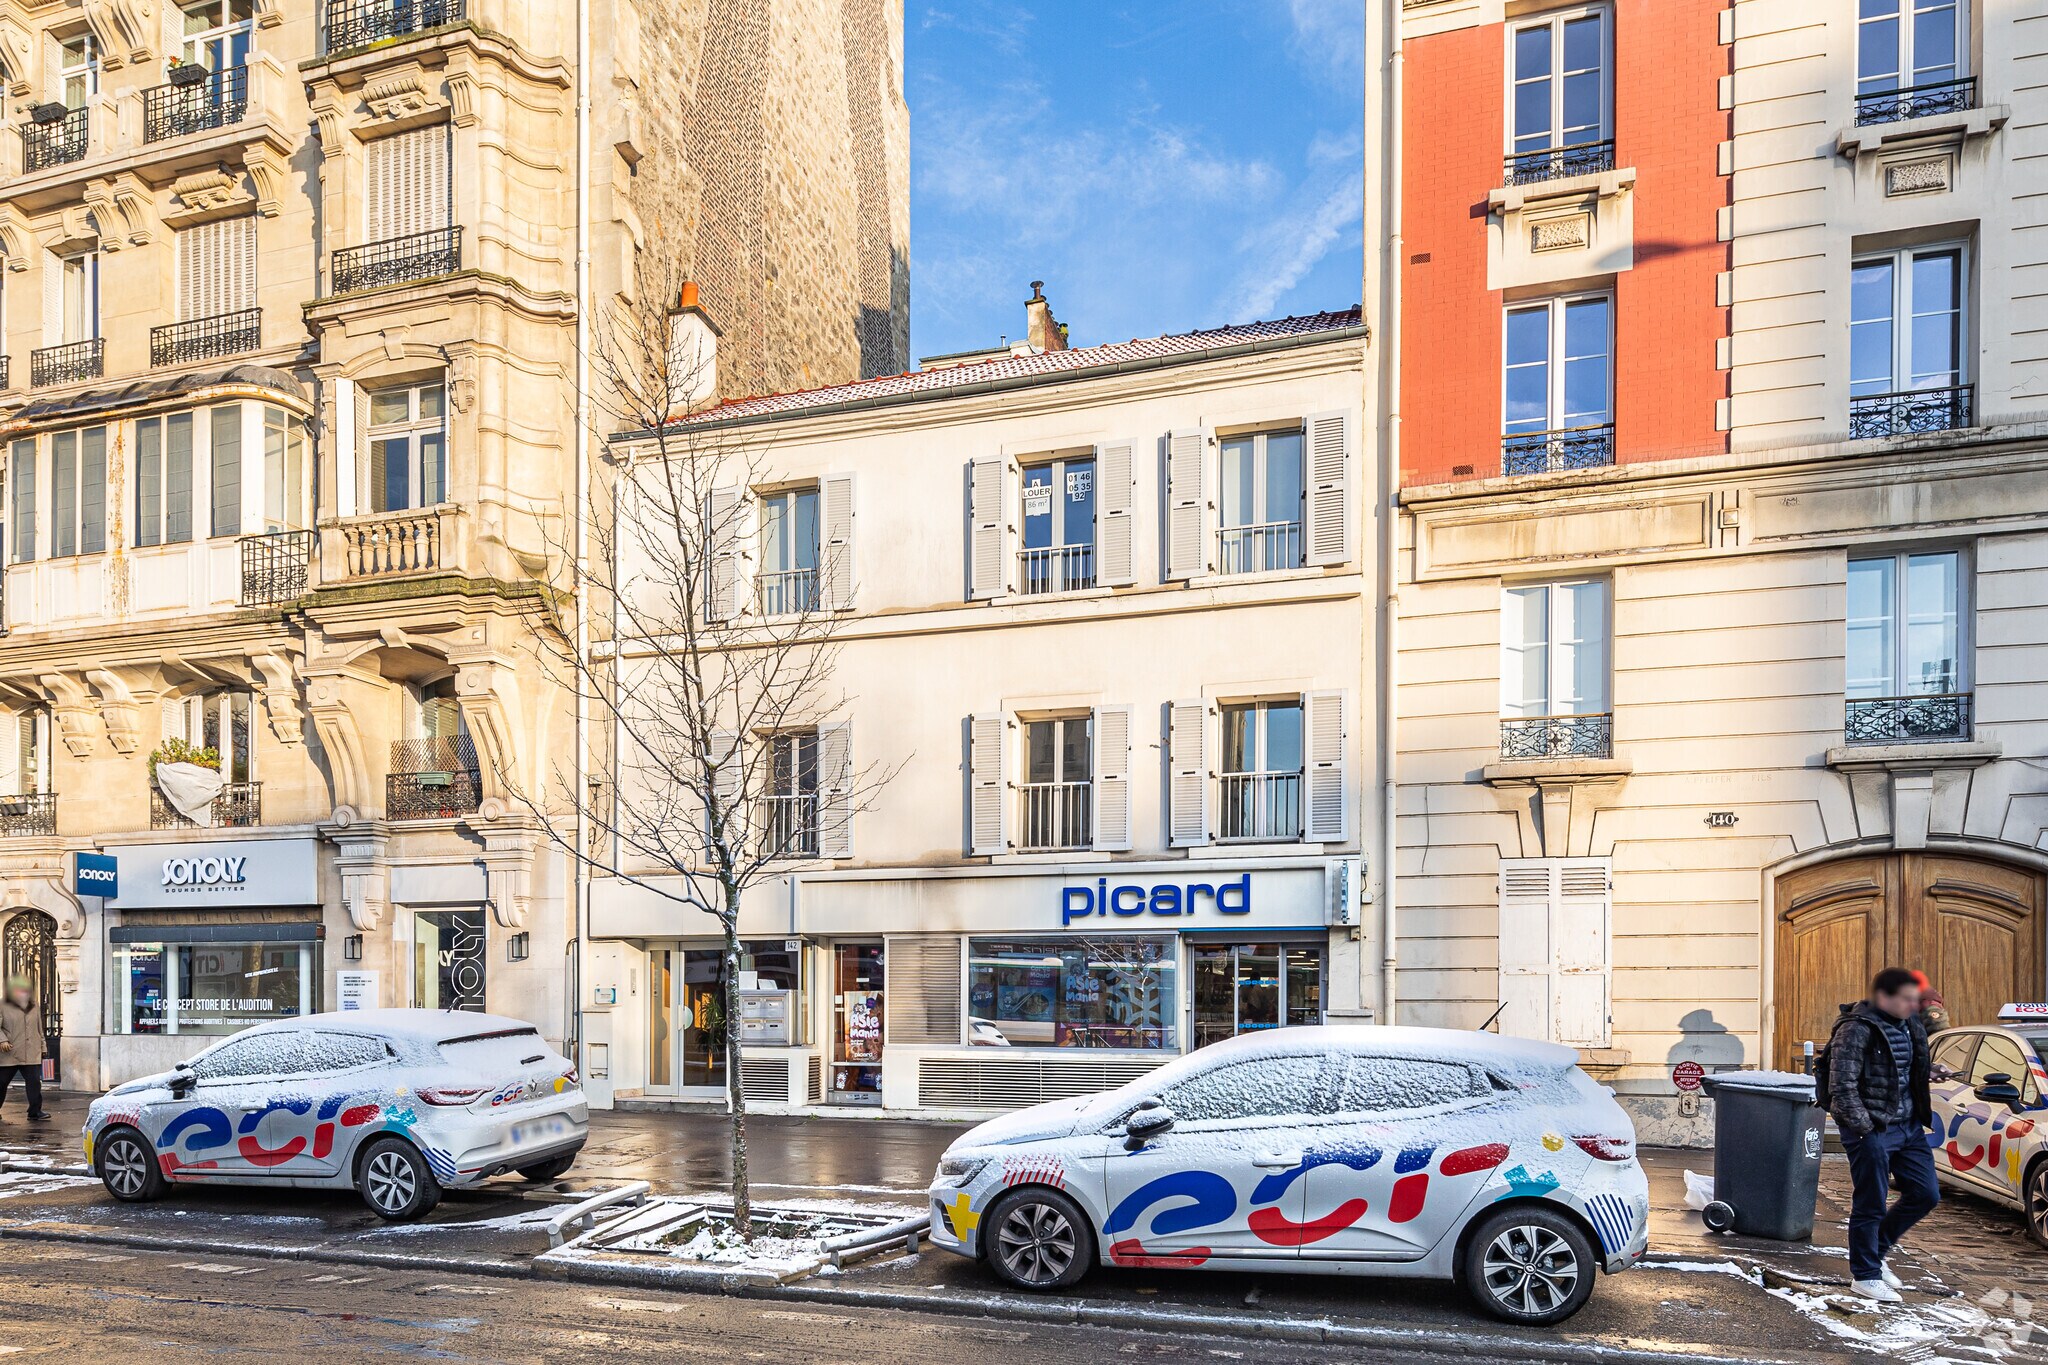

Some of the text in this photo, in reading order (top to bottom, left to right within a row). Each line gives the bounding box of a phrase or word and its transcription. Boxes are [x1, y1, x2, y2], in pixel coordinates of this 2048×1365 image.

[1068, 473, 1090, 482] 01 46
[1023, 487, 1051, 498] LOUER
[1069, 482, 1091, 492] 05 35
[1074, 492, 1085, 500] 92
[1712, 814, 1735, 825] 140
[78, 868, 116, 882] SONOLY
[161, 856, 246, 886] SONOLY
[1062, 873, 1250, 925] picard
[786, 941, 797, 949] 142
[152, 998, 273, 1010] LE CCEPT STORE DE L'AUDITION
[1678, 1062, 1699, 1070] SORTIE
